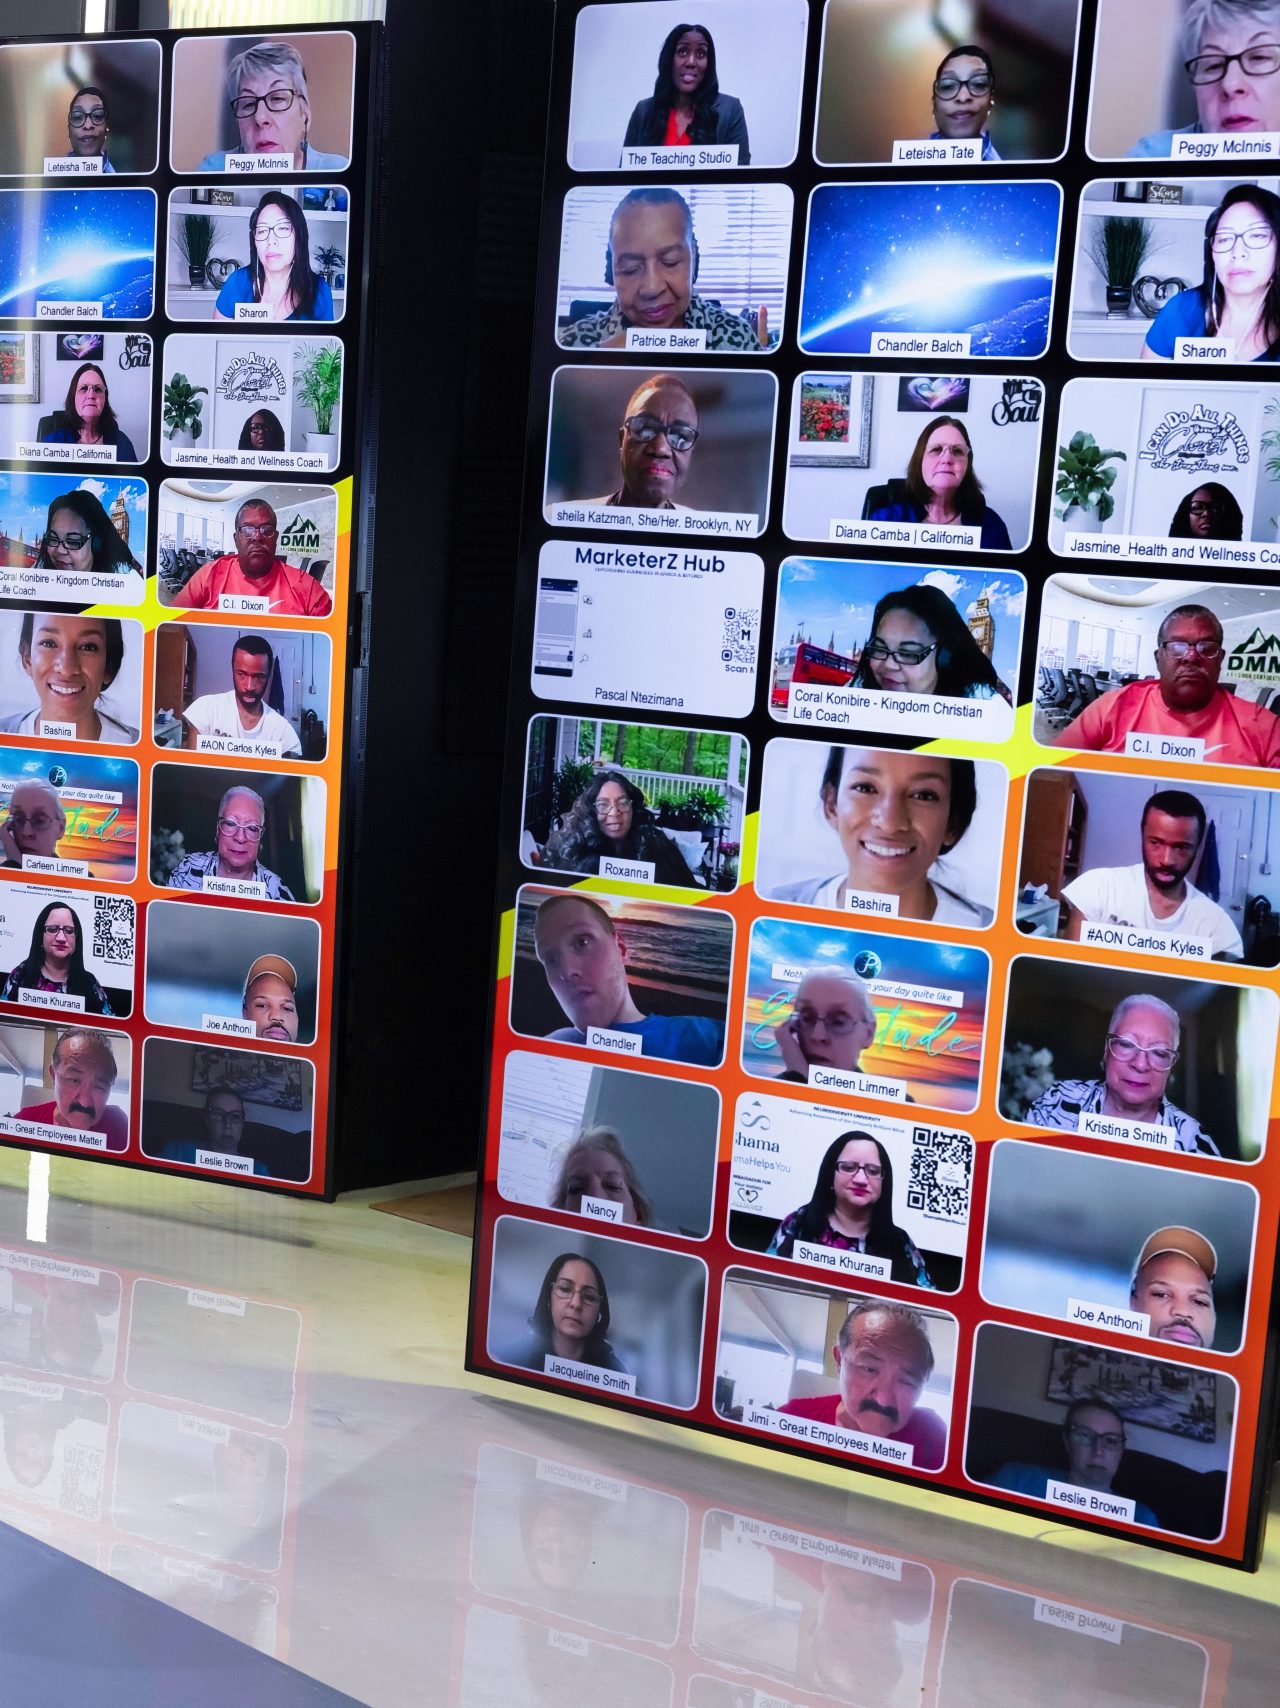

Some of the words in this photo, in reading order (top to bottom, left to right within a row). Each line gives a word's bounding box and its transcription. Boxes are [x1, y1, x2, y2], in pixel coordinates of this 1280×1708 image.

[899, 146, 946, 159] Leteisha
[950, 145, 974, 158] Tate
[1178, 140, 1218, 157] Peggy
[1223, 139, 1271, 153] McInnis
[48, 162, 79, 172] Leteisha
[81, 161, 97, 171] Tate
[628, 152, 647, 164] The
[650, 152, 695, 166] Teaching
[698, 151, 731, 163] Studio
[239, 307, 267, 317] Sharon
[631, 334, 666, 346] Patrice
[669, 334, 699, 347] Baker
[877, 338, 928, 351] Chandler
[931, 339, 962, 352] Balch
[1181, 343, 1226, 357] Sharon
[175, 453, 238, 465] Jasmine_Health
[240, 455, 255, 465] and
[258, 455, 294, 466] Wellness
[296, 456, 322, 467] Coach
[557, 509, 585, 522] sheila
[588, 511, 633, 526] Katzman,
[684, 516, 731, 533] Brooklyn,
[735, 519, 751, 531] NY
[281, 535, 320, 547] DMM
[835, 525, 866, 538] Diana
[870, 526, 909, 541] Camba
[920, 529, 973, 545] California
[1070, 539, 1167, 556] Jasmine_Health
[1171, 545, 1194, 558] and
[1199, 546, 1255, 562] Wellness
[575, 547, 677, 570] MarketerZ
[684, 554, 724, 573] Hub
[725, 664, 748, 674] Scan
[595, 687, 627, 701] Pascal
[630, 690, 683, 706] Ntezimana
[795, 689, 822, 702] Coral
[826, 692, 870, 707] Konibire
[881, 697, 929, 713] Kingdom
[933, 701, 982, 717] Christian
[793, 708, 812, 719] Life
[815, 709, 849, 723] Coach
[44, 724, 71, 736] Bashira
[201, 739, 224, 750] #AON
[227, 741, 252, 753] Carlos
[255, 744, 276, 756] Kyles
[1161, 741, 1195, 757] Dixon
[605, 862, 648, 879] Roxanna
[207, 880, 235, 892] Kristina
[238, 884, 260, 895] Smith
[851, 896, 891, 912] Bashira
[1087, 928, 1123, 944] #AON
[1127, 933, 1165, 950] Carlos
[1170, 939, 1203, 955] Kyles
[894, 985, 911, 998] day
[911, 988, 934, 1001] quite
[936, 992, 952, 1003] like
[592, 1034, 636, 1050] Chandler
[814, 1072, 855, 1089] Carleen
[858, 1079, 899, 1096] Limmer
[1085, 1120, 1128, 1138] Kristina
[1133, 1127, 1167, 1144] Smith
[200, 1154, 222, 1166] Leslie
[224, 1158, 248, 1171] Brown
[586, 1202, 616, 1220] Nancy
[799, 1248, 835, 1265] Shama
[839, 1255, 883, 1275] Khurana
[1073, 1306, 1094, 1321] Joe
[1096, 1311, 1142, 1331] Anthoni
[549, 1362, 599, 1383] Jacqueline
[602, 1374, 629, 1391] Smith
[748, 1411, 768, 1426] Jimi
[779, 1418, 807, 1436] Great
[810, 1426, 868, 1451] Employees
[872, 1441, 906, 1460] Matter
[1053, 1487, 1086, 1506] Leslie
[1090, 1496, 1127, 1516] Brown
